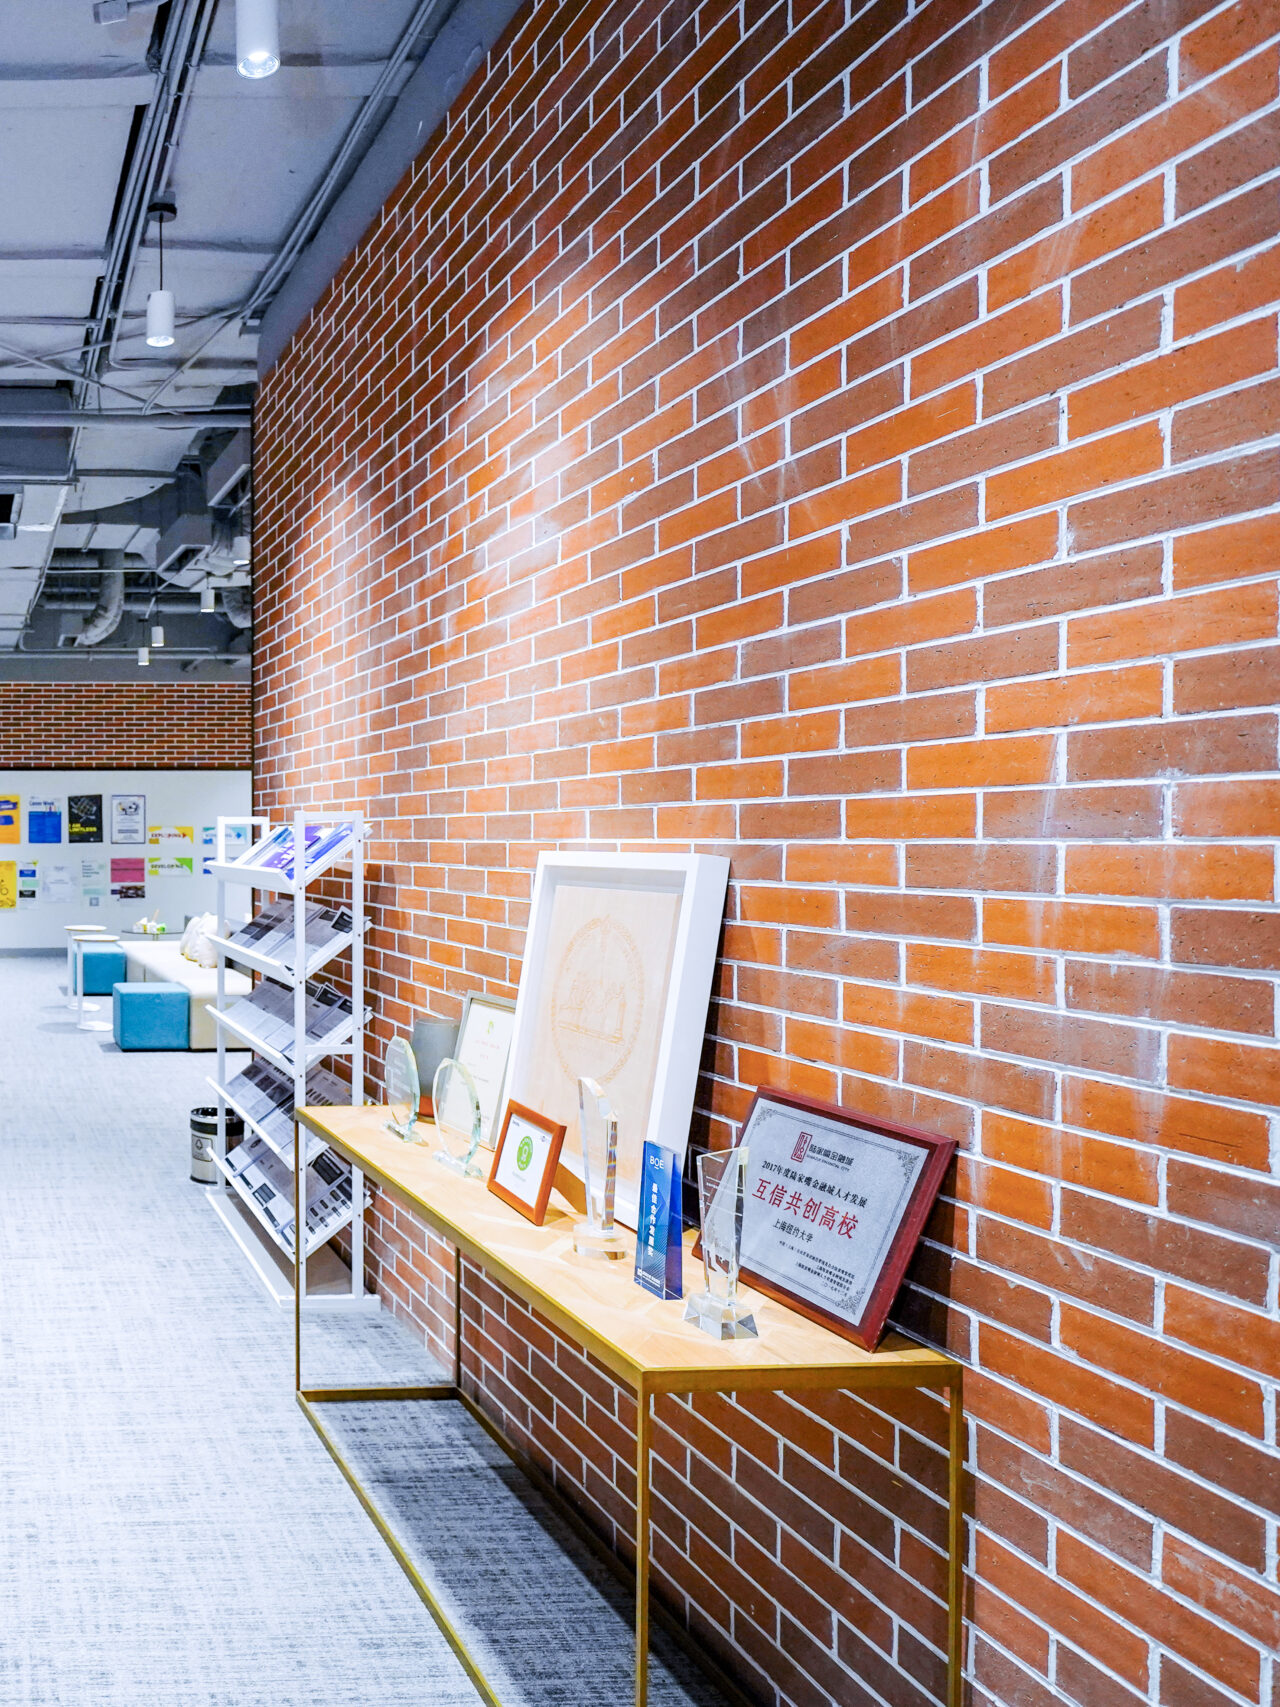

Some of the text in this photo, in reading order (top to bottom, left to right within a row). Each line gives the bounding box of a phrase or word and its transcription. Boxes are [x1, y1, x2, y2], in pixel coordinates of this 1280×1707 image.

[649, 1155, 665, 1170] BOE
[761, 1160, 868, 1208] 2017年度陆家嘴金融城人才发展
[752, 1178, 859, 1239] 互信共创高校
[772, 1218, 814, 1243] 上海纽约大学
